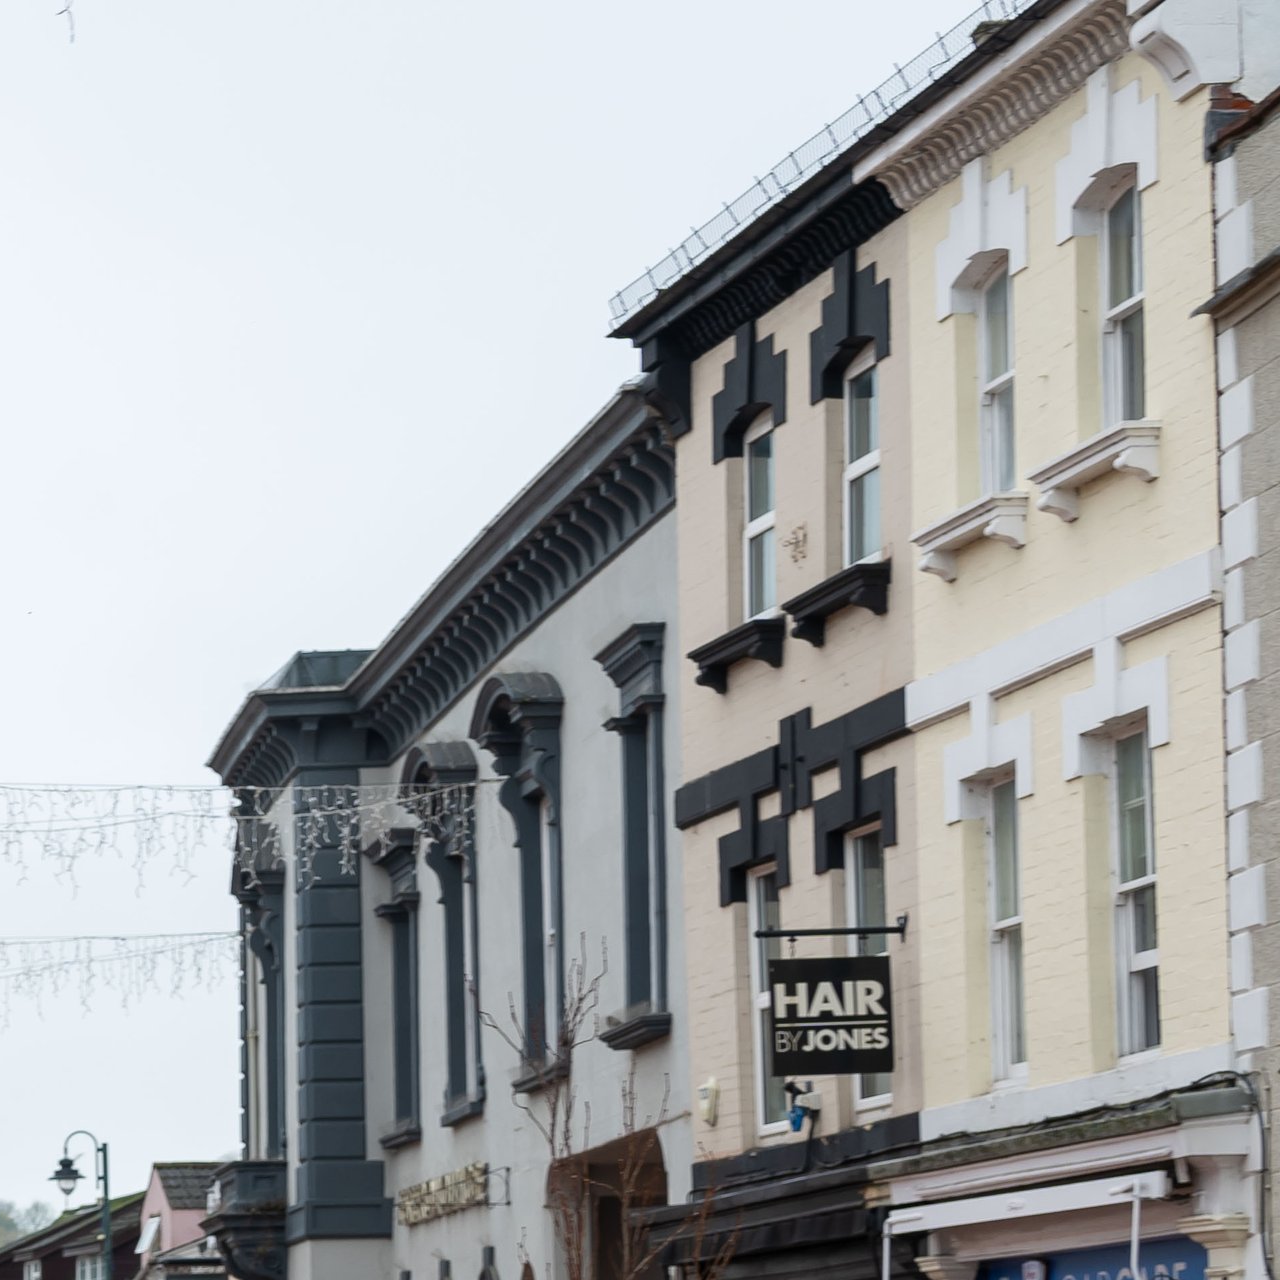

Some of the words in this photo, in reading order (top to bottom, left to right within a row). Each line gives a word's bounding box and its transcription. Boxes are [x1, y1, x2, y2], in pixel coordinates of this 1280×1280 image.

[773, 980, 888, 1019] HAIR
[775, 1030, 802, 1053] BY
[802, 1027, 890, 1052] JONES
